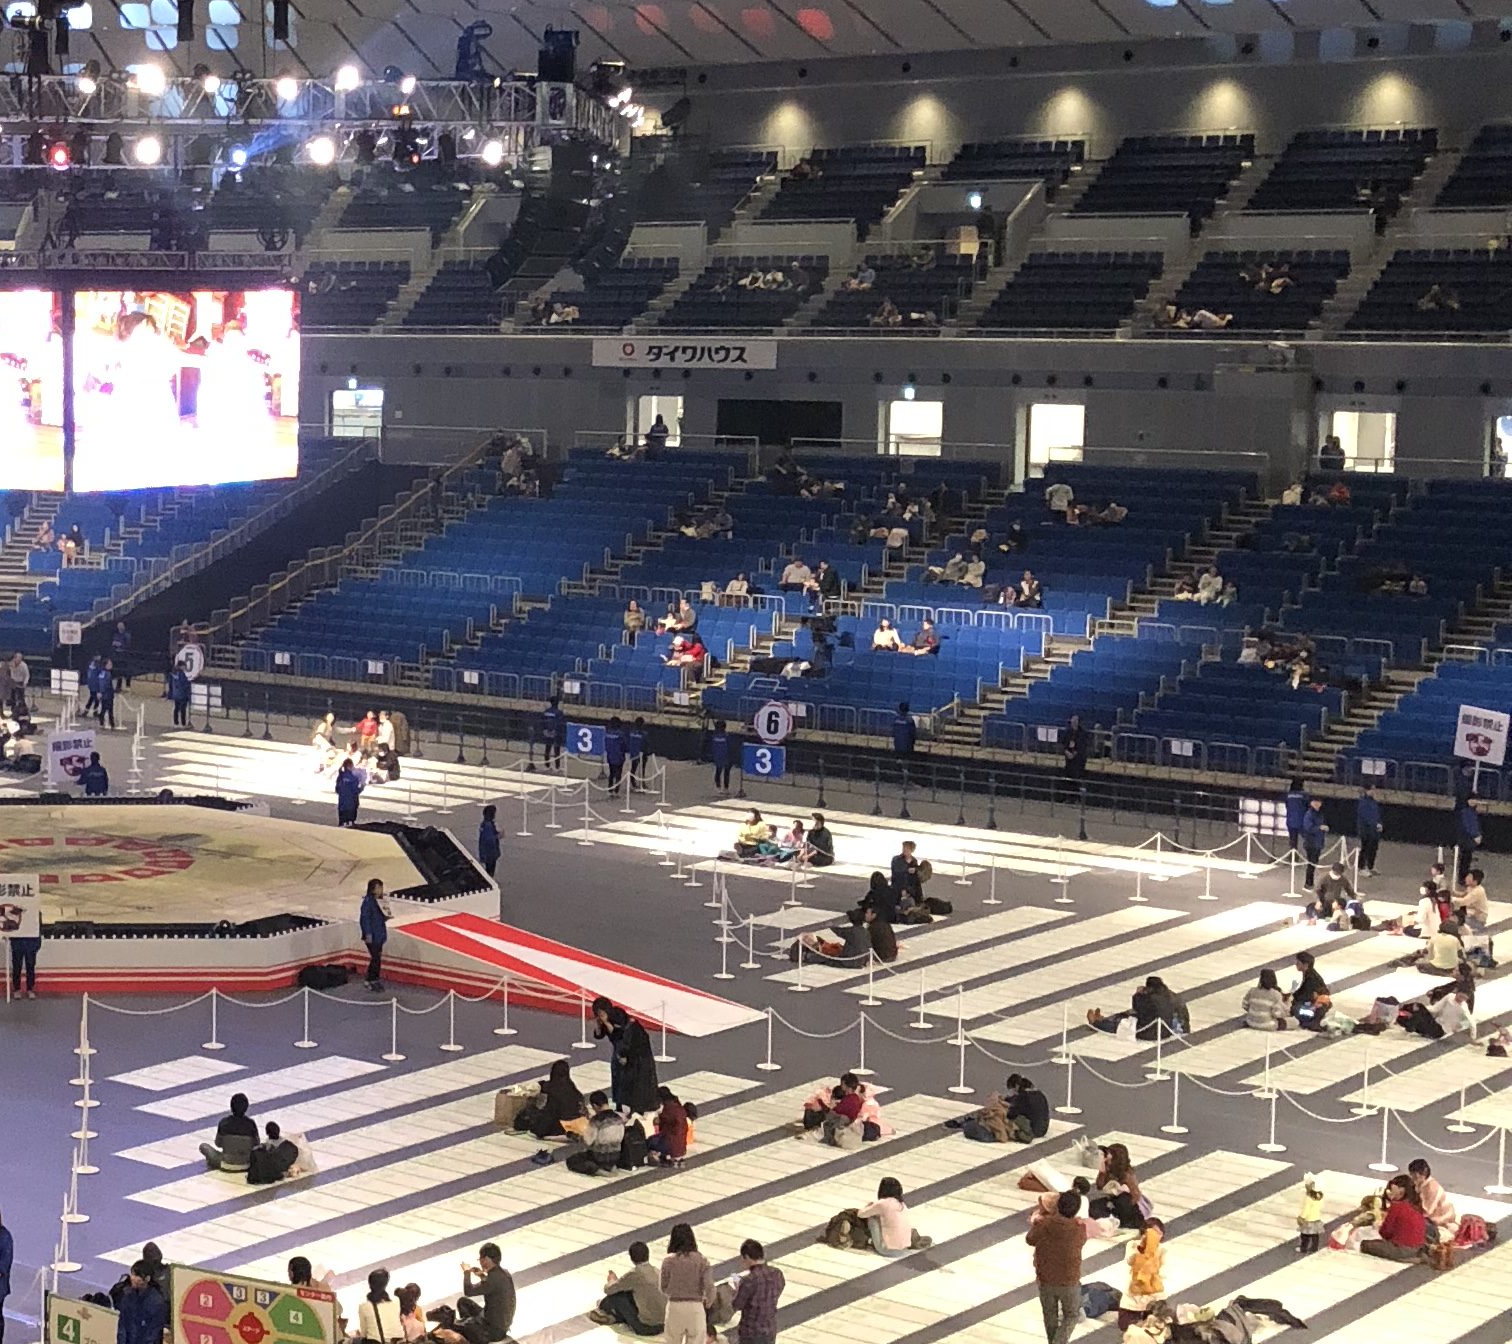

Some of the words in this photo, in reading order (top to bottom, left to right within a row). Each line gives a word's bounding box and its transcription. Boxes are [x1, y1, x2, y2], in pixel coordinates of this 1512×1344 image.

[645, 344, 748, 364] ダイワハウス
[185, 652, 194, 673] 5
[765, 710, 780, 735] 6
[577, 727, 593, 752] 3
[755, 748, 772, 774] 3
[62, 1318, 76, 1341] 4
